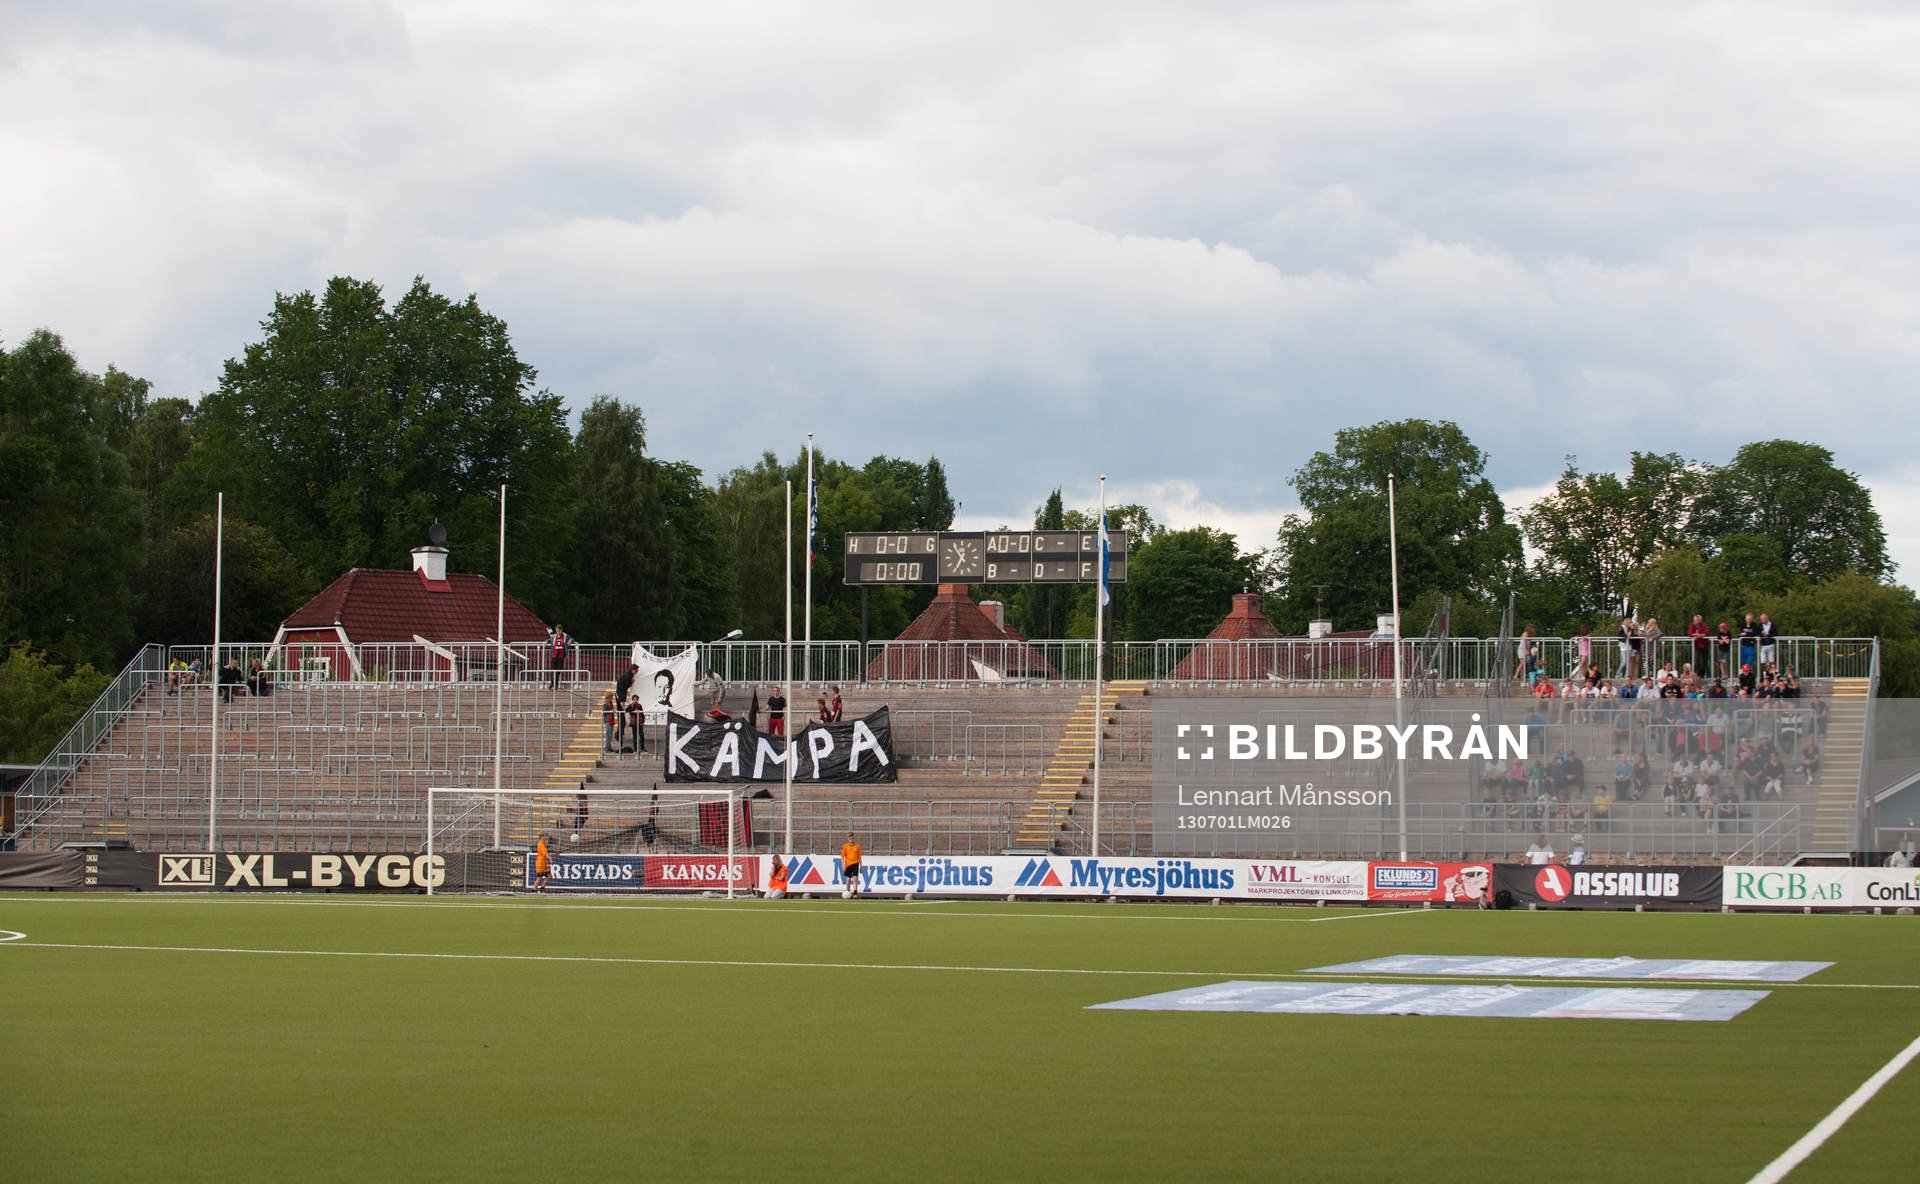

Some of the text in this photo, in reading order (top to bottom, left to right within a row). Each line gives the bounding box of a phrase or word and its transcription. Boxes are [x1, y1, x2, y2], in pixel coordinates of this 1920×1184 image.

[849, 536, 935, 553] H 0-0 G
[987, 535, 1030, 553] A 0-0
[1035, 537, 1044, 552] C
[1082, 536, 1092, 550] E
[876, 562, 920, 580] 0:00
[987, 563, 997, 578] B
[1034, 563, 1044, 578] D
[1081, 563, 1091, 578] F
[668, 720, 889, 779] KÄMPA
[163, 858, 210, 881] XL
[224, 854, 445, 888] XL-BYGG
[549, 863, 633, 880] RISTADS
[661, 863, 743, 880] KANSAS
[1070, 859, 1234, 895] Myresjöhus
[1250, 865, 1302, 883] VML
[1313, 874, 1350, 884] KONSULT
[1378, 869, 1422, 881] EKLUNDS
[1573, 872, 1679, 897] ASSALUB
[1735, 872, 1843, 900] RGB AB
